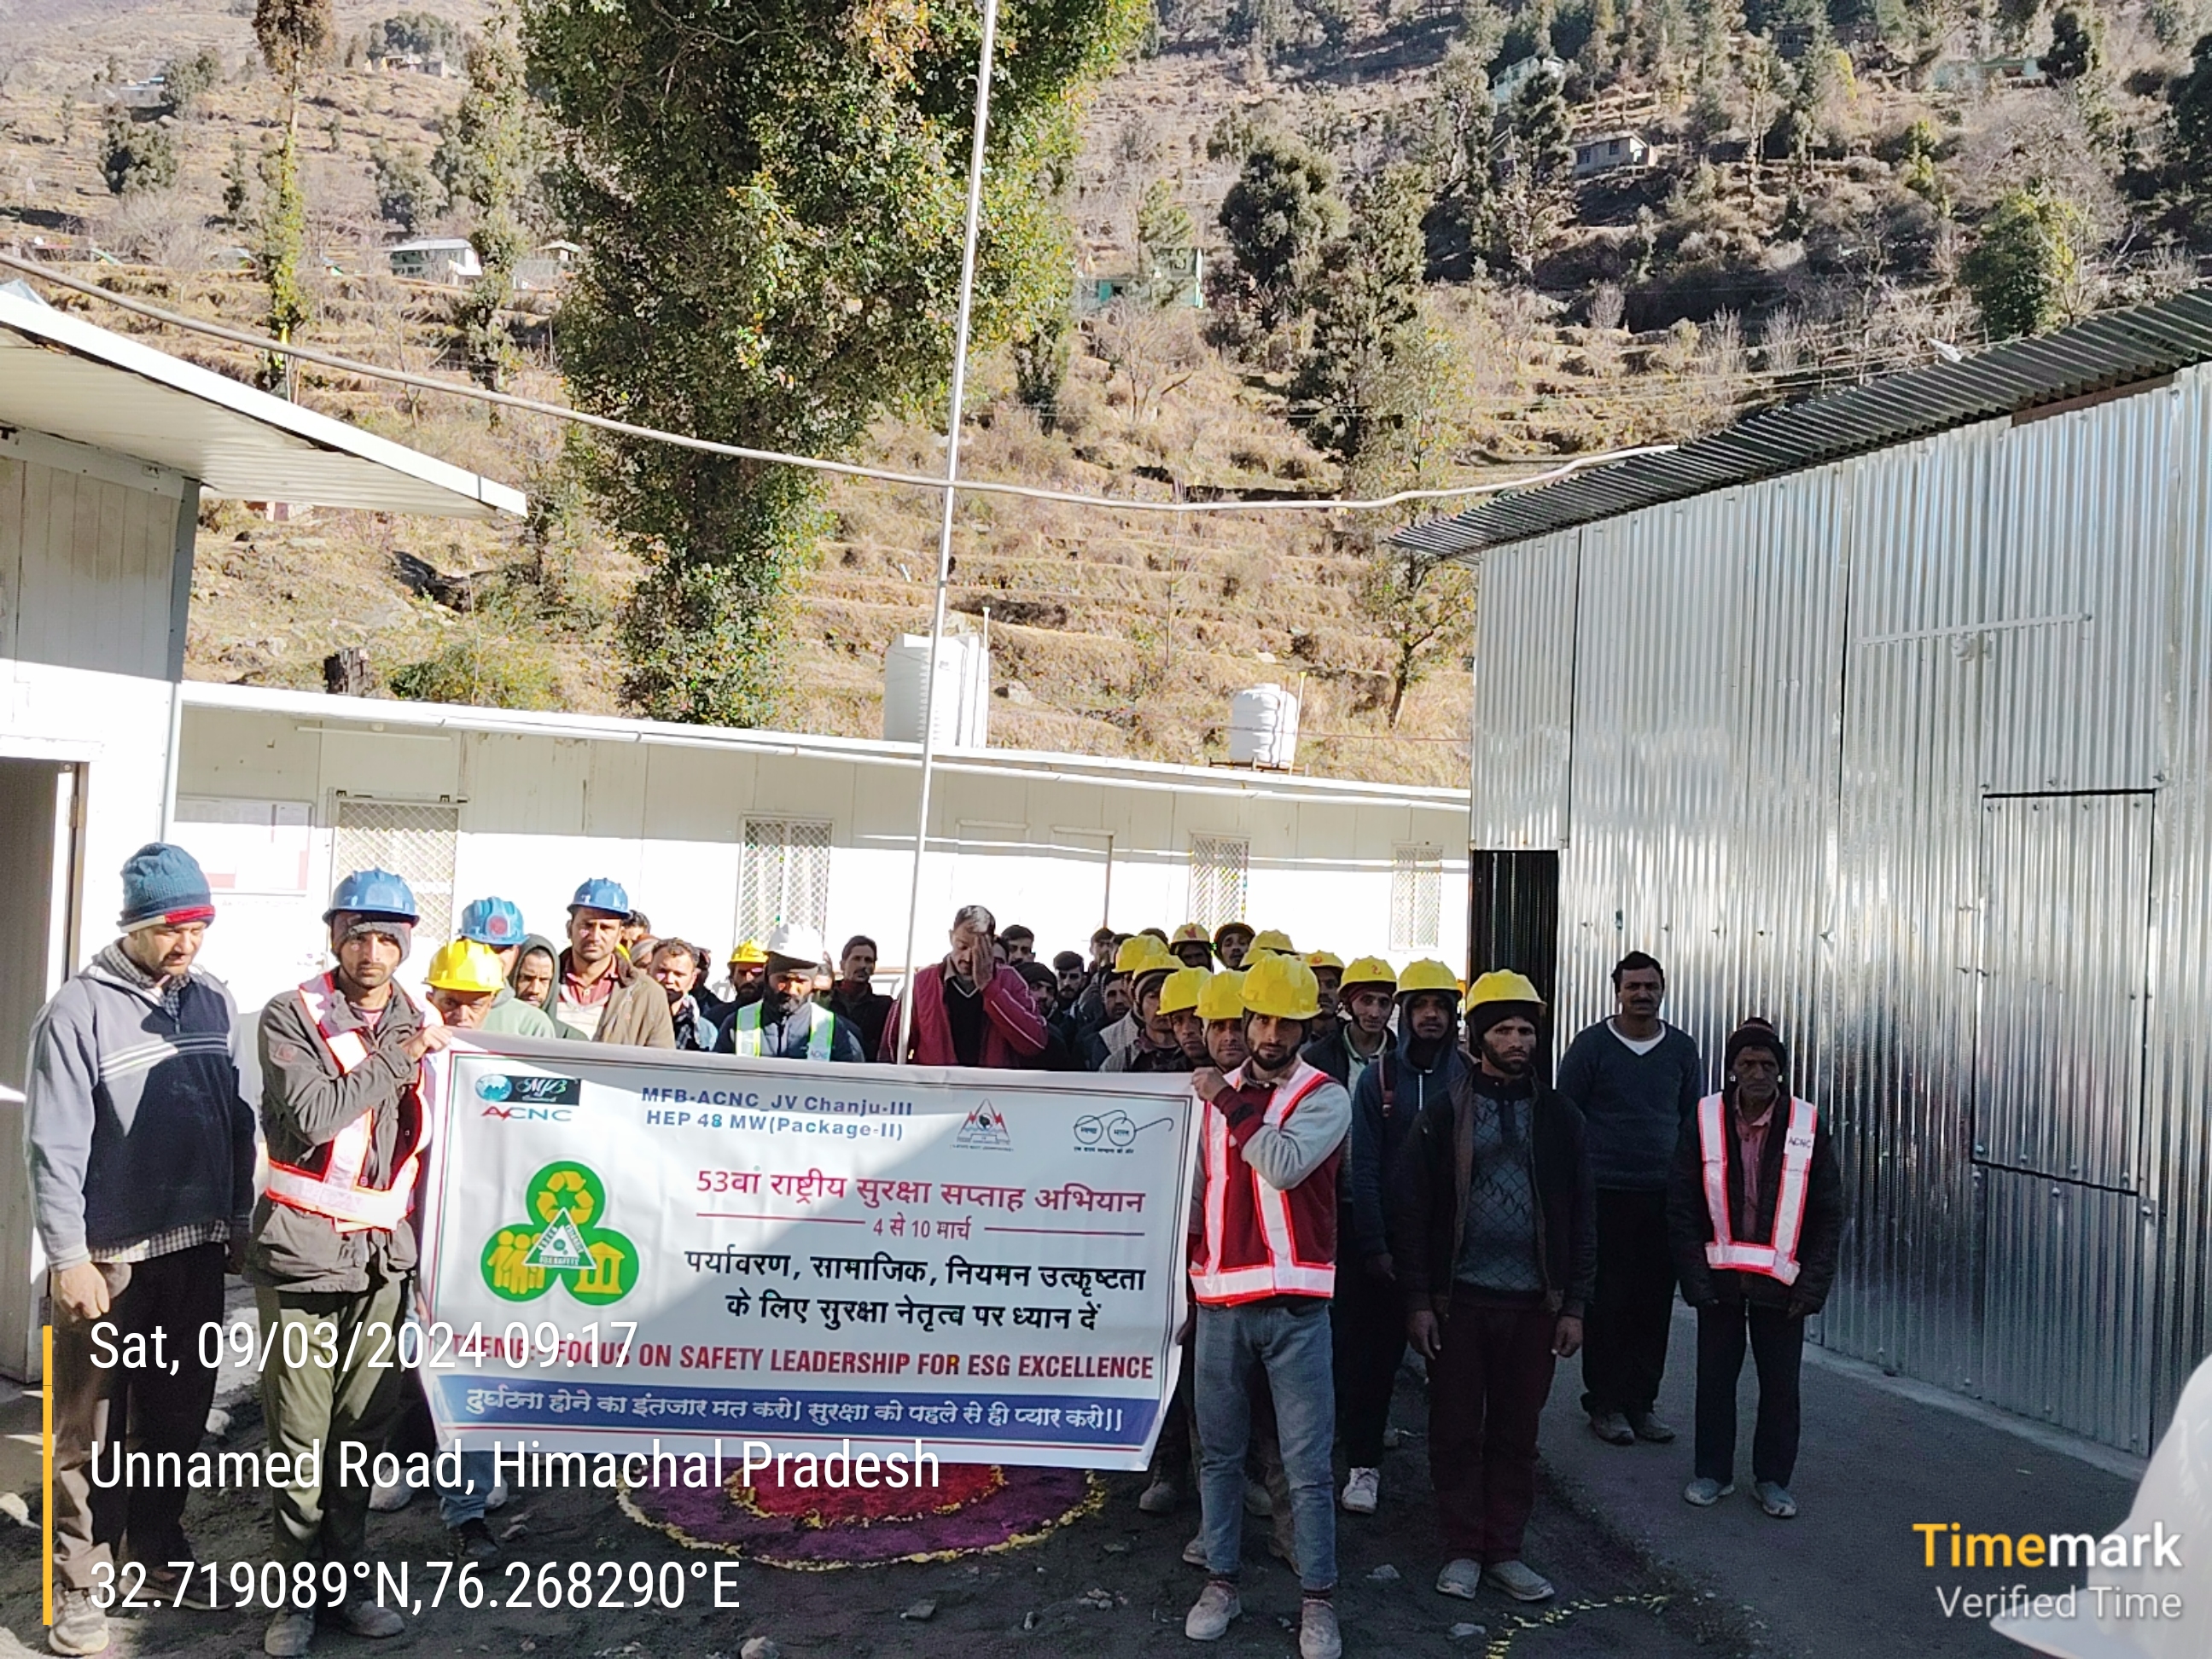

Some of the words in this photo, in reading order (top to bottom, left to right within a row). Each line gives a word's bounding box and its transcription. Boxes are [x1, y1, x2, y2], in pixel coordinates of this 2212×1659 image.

[646, 1110, 690, 1126] HEP
[697, 1114, 722, 1127] 48
[805, 1096, 912, 1116] Chanju-III
[771, 1167, 847, 1204] राष्ट्रीय
[856, 1179, 932, 1208] सुरक्षा
[940, 1184, 1026, 1212] सप्ताह
[1034, 1183, 1145, 1213] अभियान
[873, 1218, 883, 1236] 4
[889, 1212, 905, 1237] से
[911, 1220, 930, 1237] 10
[937, 1215, 972, 1240] मार्च
[946, 1254, 1031, 1286] नियमन
[1038, 1266, 1146, 1297] उत्कृष्टता
[725, 1287, 751, 1317] के
[759, 1289, 810, 1324] लिए
[817, 1299, 888, 1330] सुरक्षा
[895, 1294, 965, 1332] नेतृत्व
[972, 1306, 1005, 1326] पर
[1013, 1307, 1071, 1329] ध्यान
[1078, 1301, 1102, 1330] दें
[638, 1343, 671, 1367] ON
[680, 1345, 763, 1371] SAFETY
[771, 1349, 911, 1374] LEADERSHIP
[917, 1353, 960, 1375] FOR
[968, 1354, 1010, 1376] ESG
[1018, 1356, 1154, 1379] EXCELLENCE
[466, 1383, 544, 1414] दुर्घटना
[549, 1388, 591, 1413] होने
[597, 1395, 627, 1413] का
[632, 1393, 707, 1417] इंतजार
[712, 1400, 748, 1417] मत
[808, 1402, 870, 1426] सुरक्षा
[874, 1400, 903, 1422] को
[909, 1400, 958, 1424] पहले
[963, 1400, 982, 1425] से
[987, 1401, 1010, 1427] ही
[1015, 1407, 1061, 1428] प्यार
